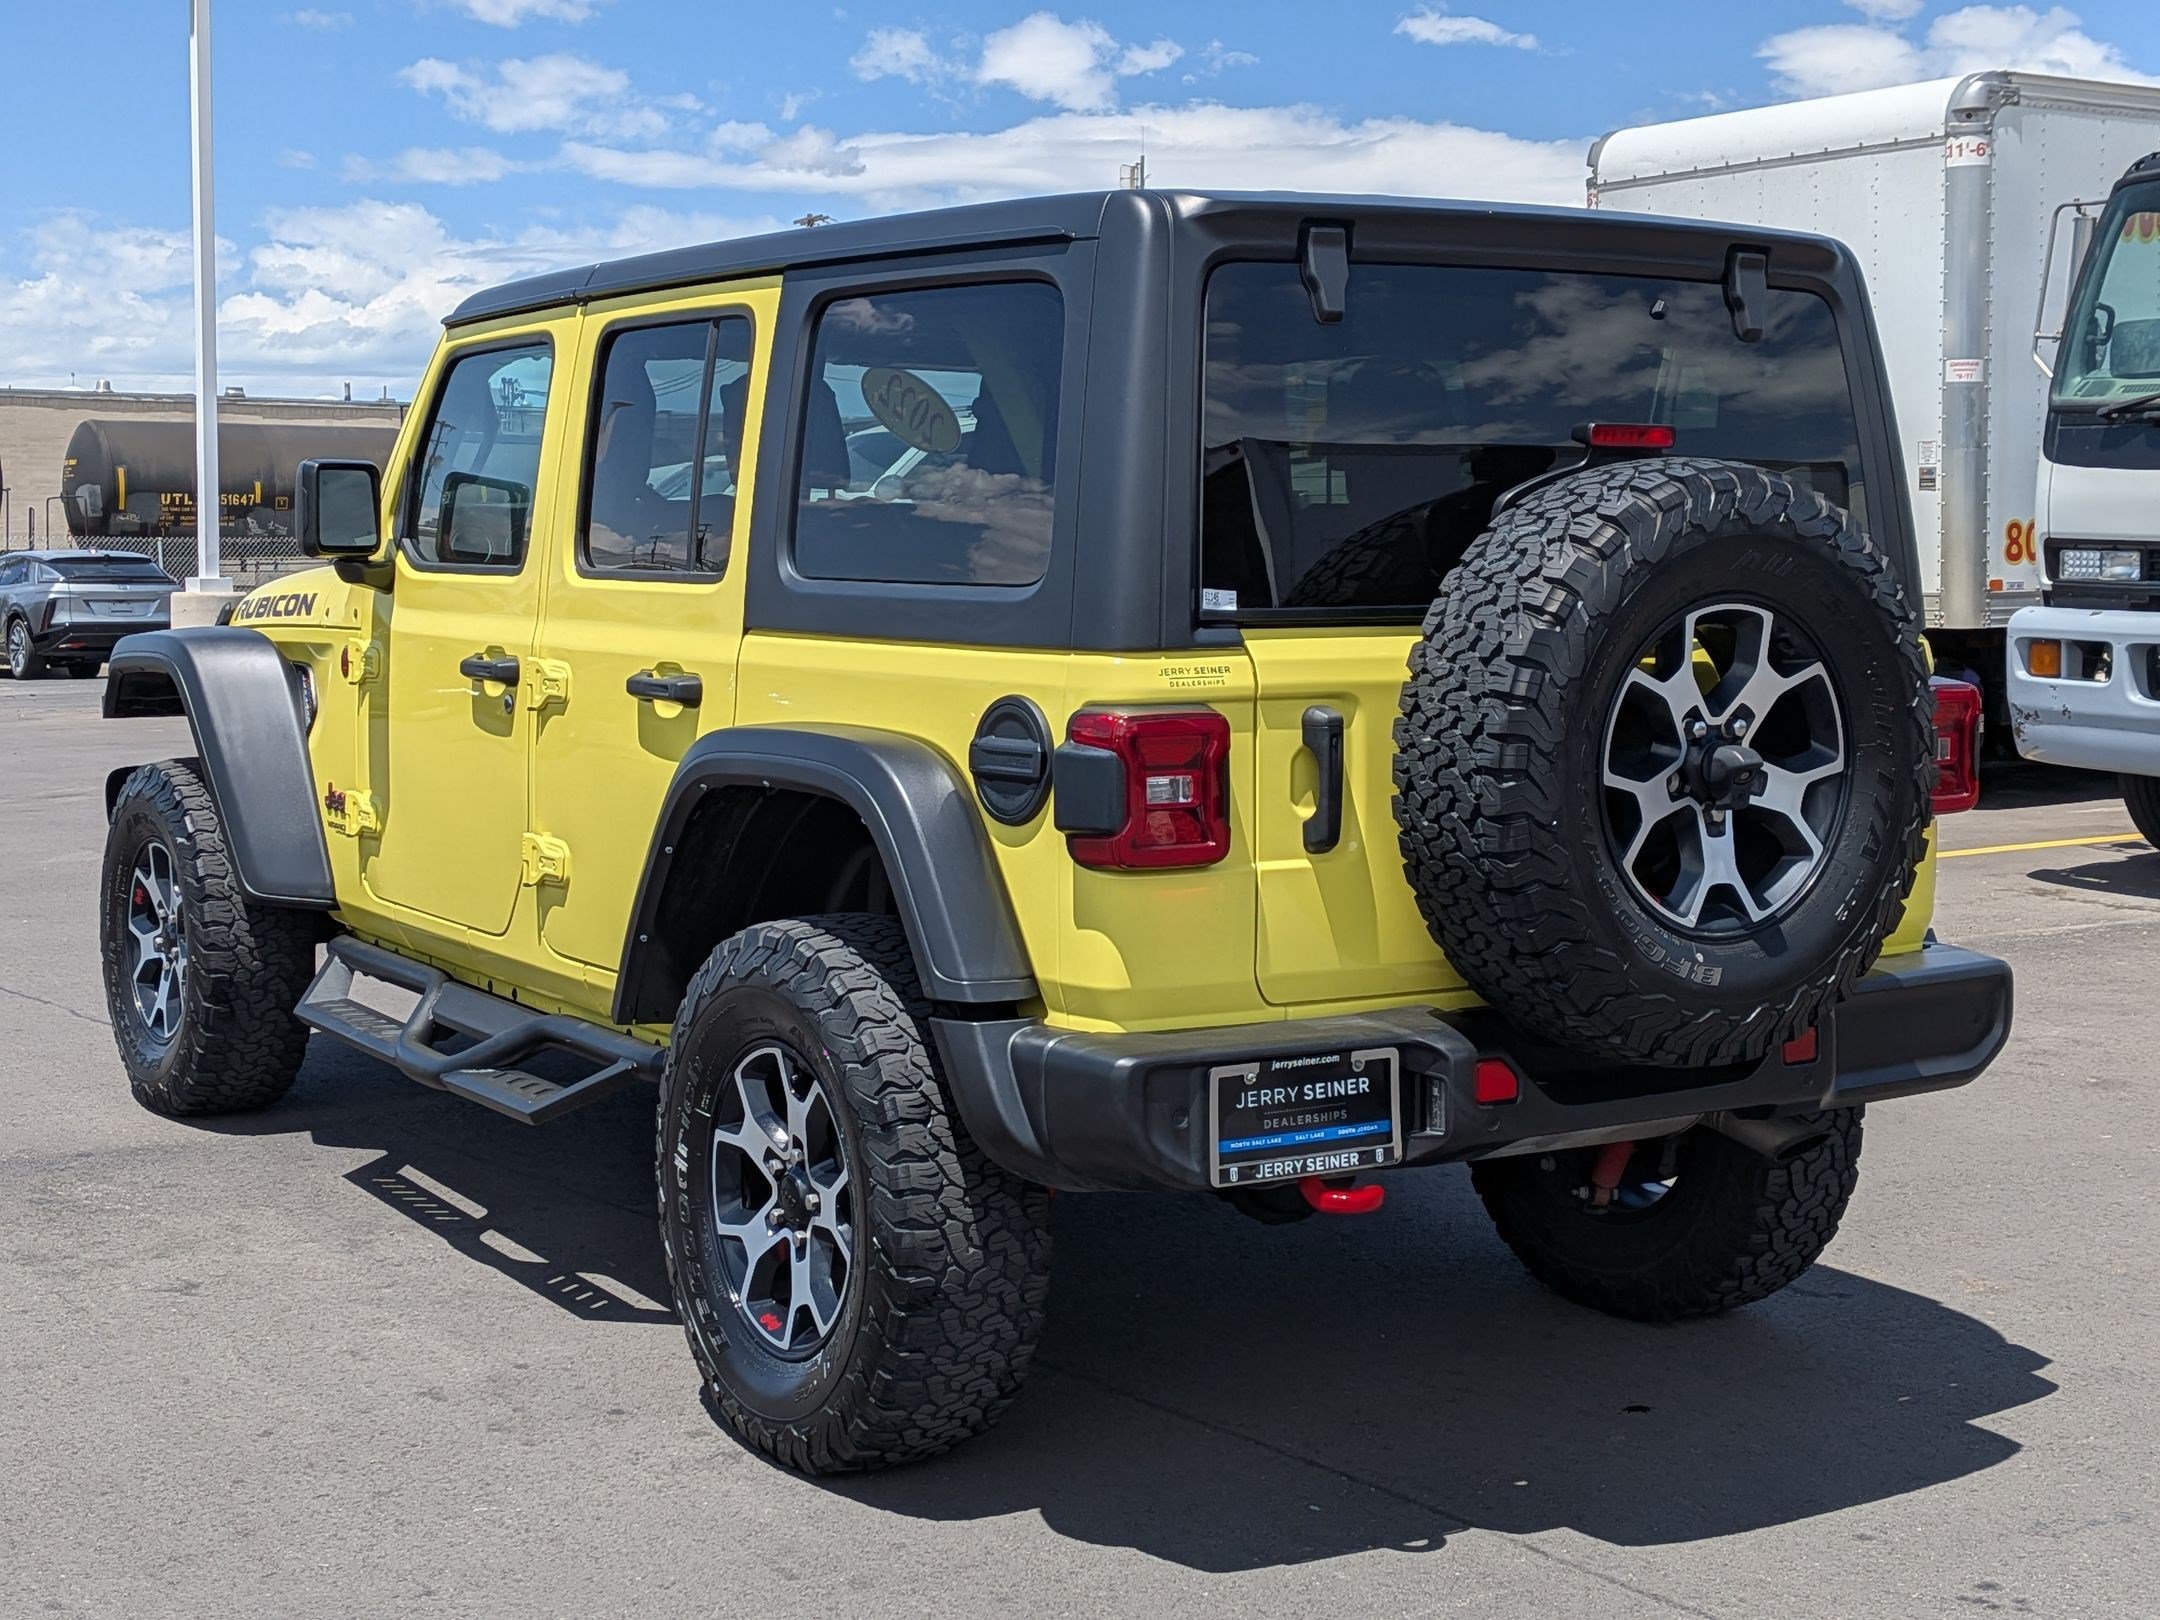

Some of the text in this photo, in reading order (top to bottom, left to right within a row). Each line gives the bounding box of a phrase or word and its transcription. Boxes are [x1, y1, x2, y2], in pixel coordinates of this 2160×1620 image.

[160, 493, 255, 506] UTL 51647
[234, 592, 318, 621] RUBICON
[1158, 666, 1231, 677] JERRY SEINER
[1169, 679, 1226, 688] DEALERSHIPS
[1271, 1054, 1340, 1071] jerryseiner.com
[1236, 1077, 1370, 1109] JERRY SEINER
[1263, 1109, 1348, 1129] DEALERSHIPS
[1267, 1137, 1282, 1145] LAKE
[1310, 1131, 1325, 1139] LAKE
[1255, 1152, 1360, 1179] JERRY SEINER
